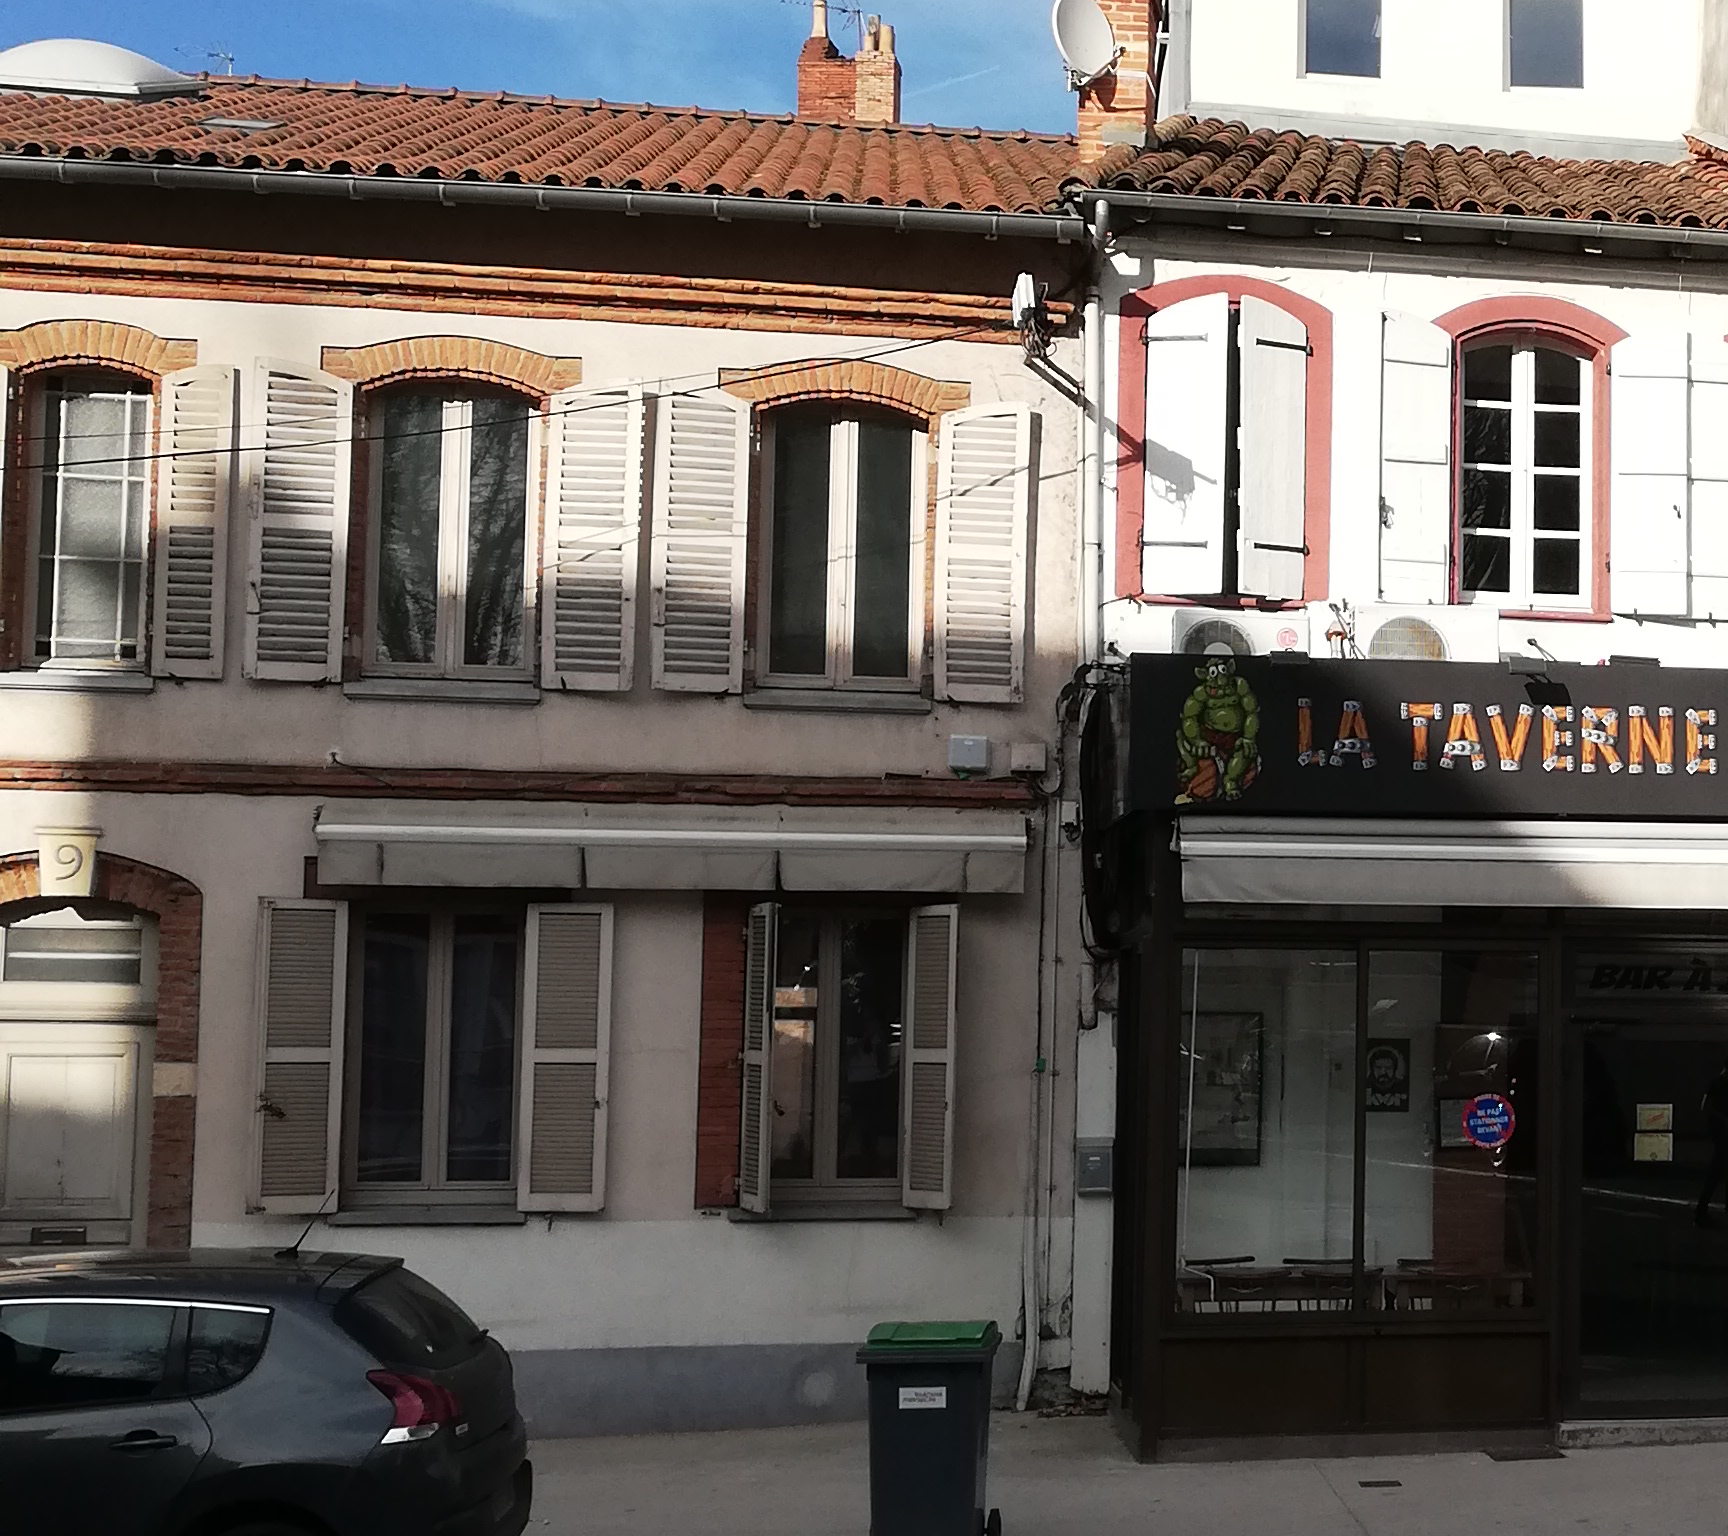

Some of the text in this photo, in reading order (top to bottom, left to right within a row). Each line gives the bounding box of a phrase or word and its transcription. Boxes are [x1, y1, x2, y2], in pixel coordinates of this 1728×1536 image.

[1297, 696, 1378, 768] LA
[1399, 701, 1718, 775] TAVERNE
[55, 844, 83, 881] 9
[1589, 964, 1674, 991] BAR
[1682, 956, 1713, 992] À
